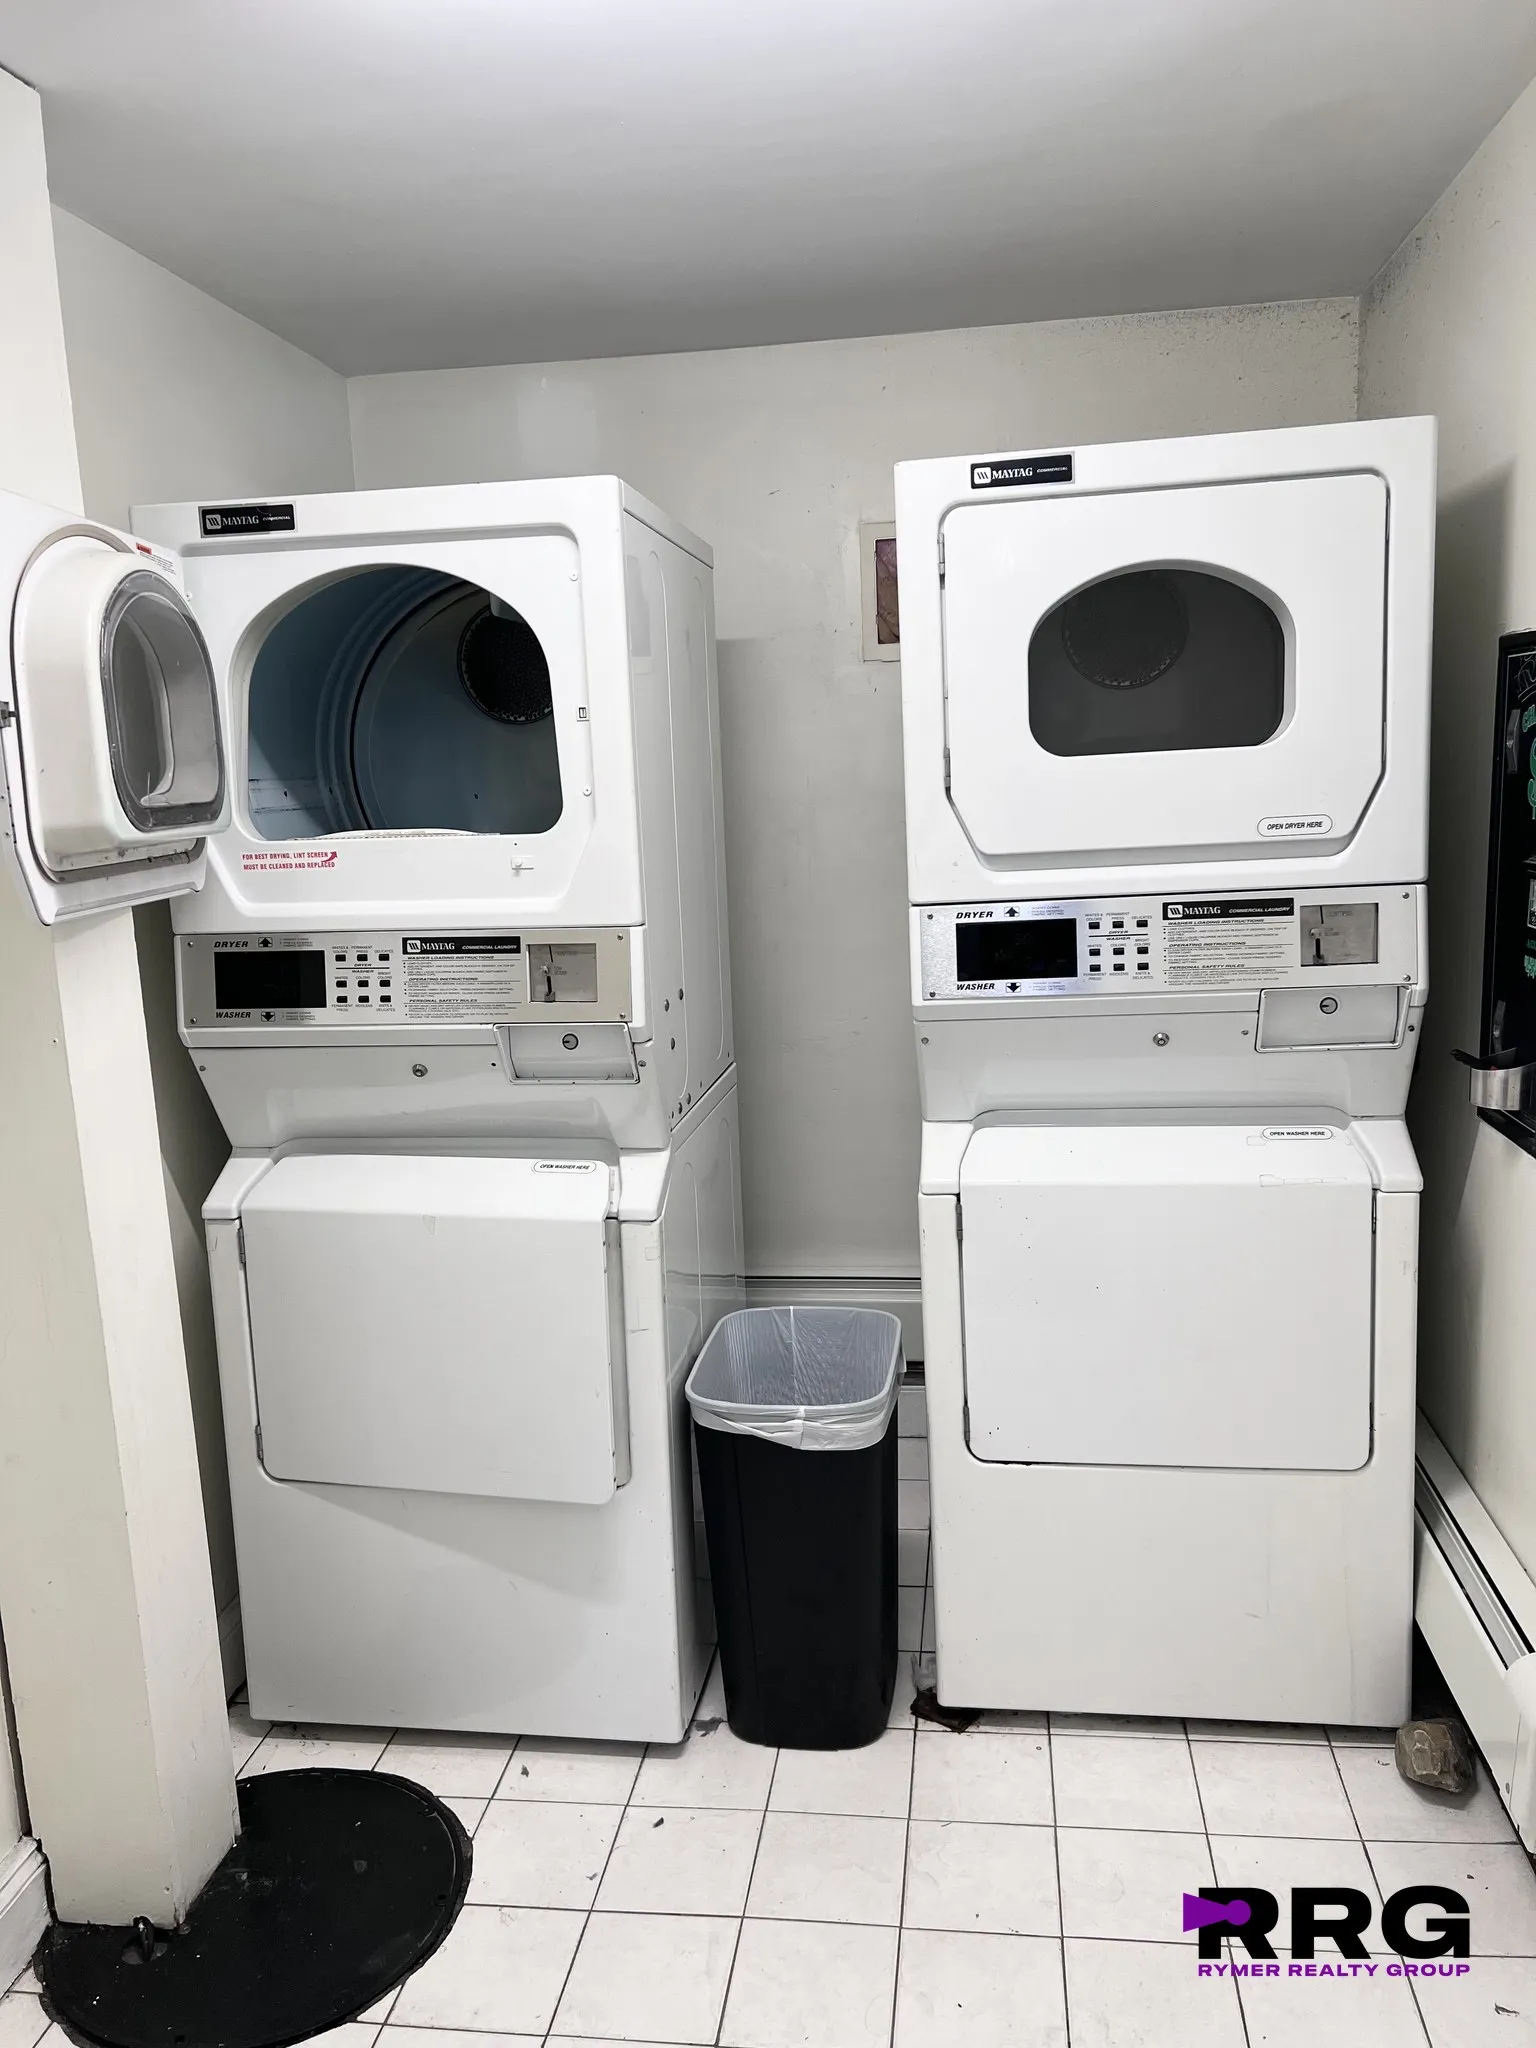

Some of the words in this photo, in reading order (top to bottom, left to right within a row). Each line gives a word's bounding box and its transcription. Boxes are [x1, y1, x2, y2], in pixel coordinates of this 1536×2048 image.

[992, 467, 1033, 480] MAYTAG
[222, 515, 259, 526] MAYTAG
[307, 851, 328, 859] SCREEN
[307, 861, 335, 869] REPLACED
[1183, 906, 1221, 915] MAYTAG
[956, 911, 994, 919] DRYER
[213, 940, 249, 948] DRYER
[421, 942, 456, 951] MAYTAG
[956, 983, 995, 991] WASHER
[215, 1011, 251, 1019] WASHER
